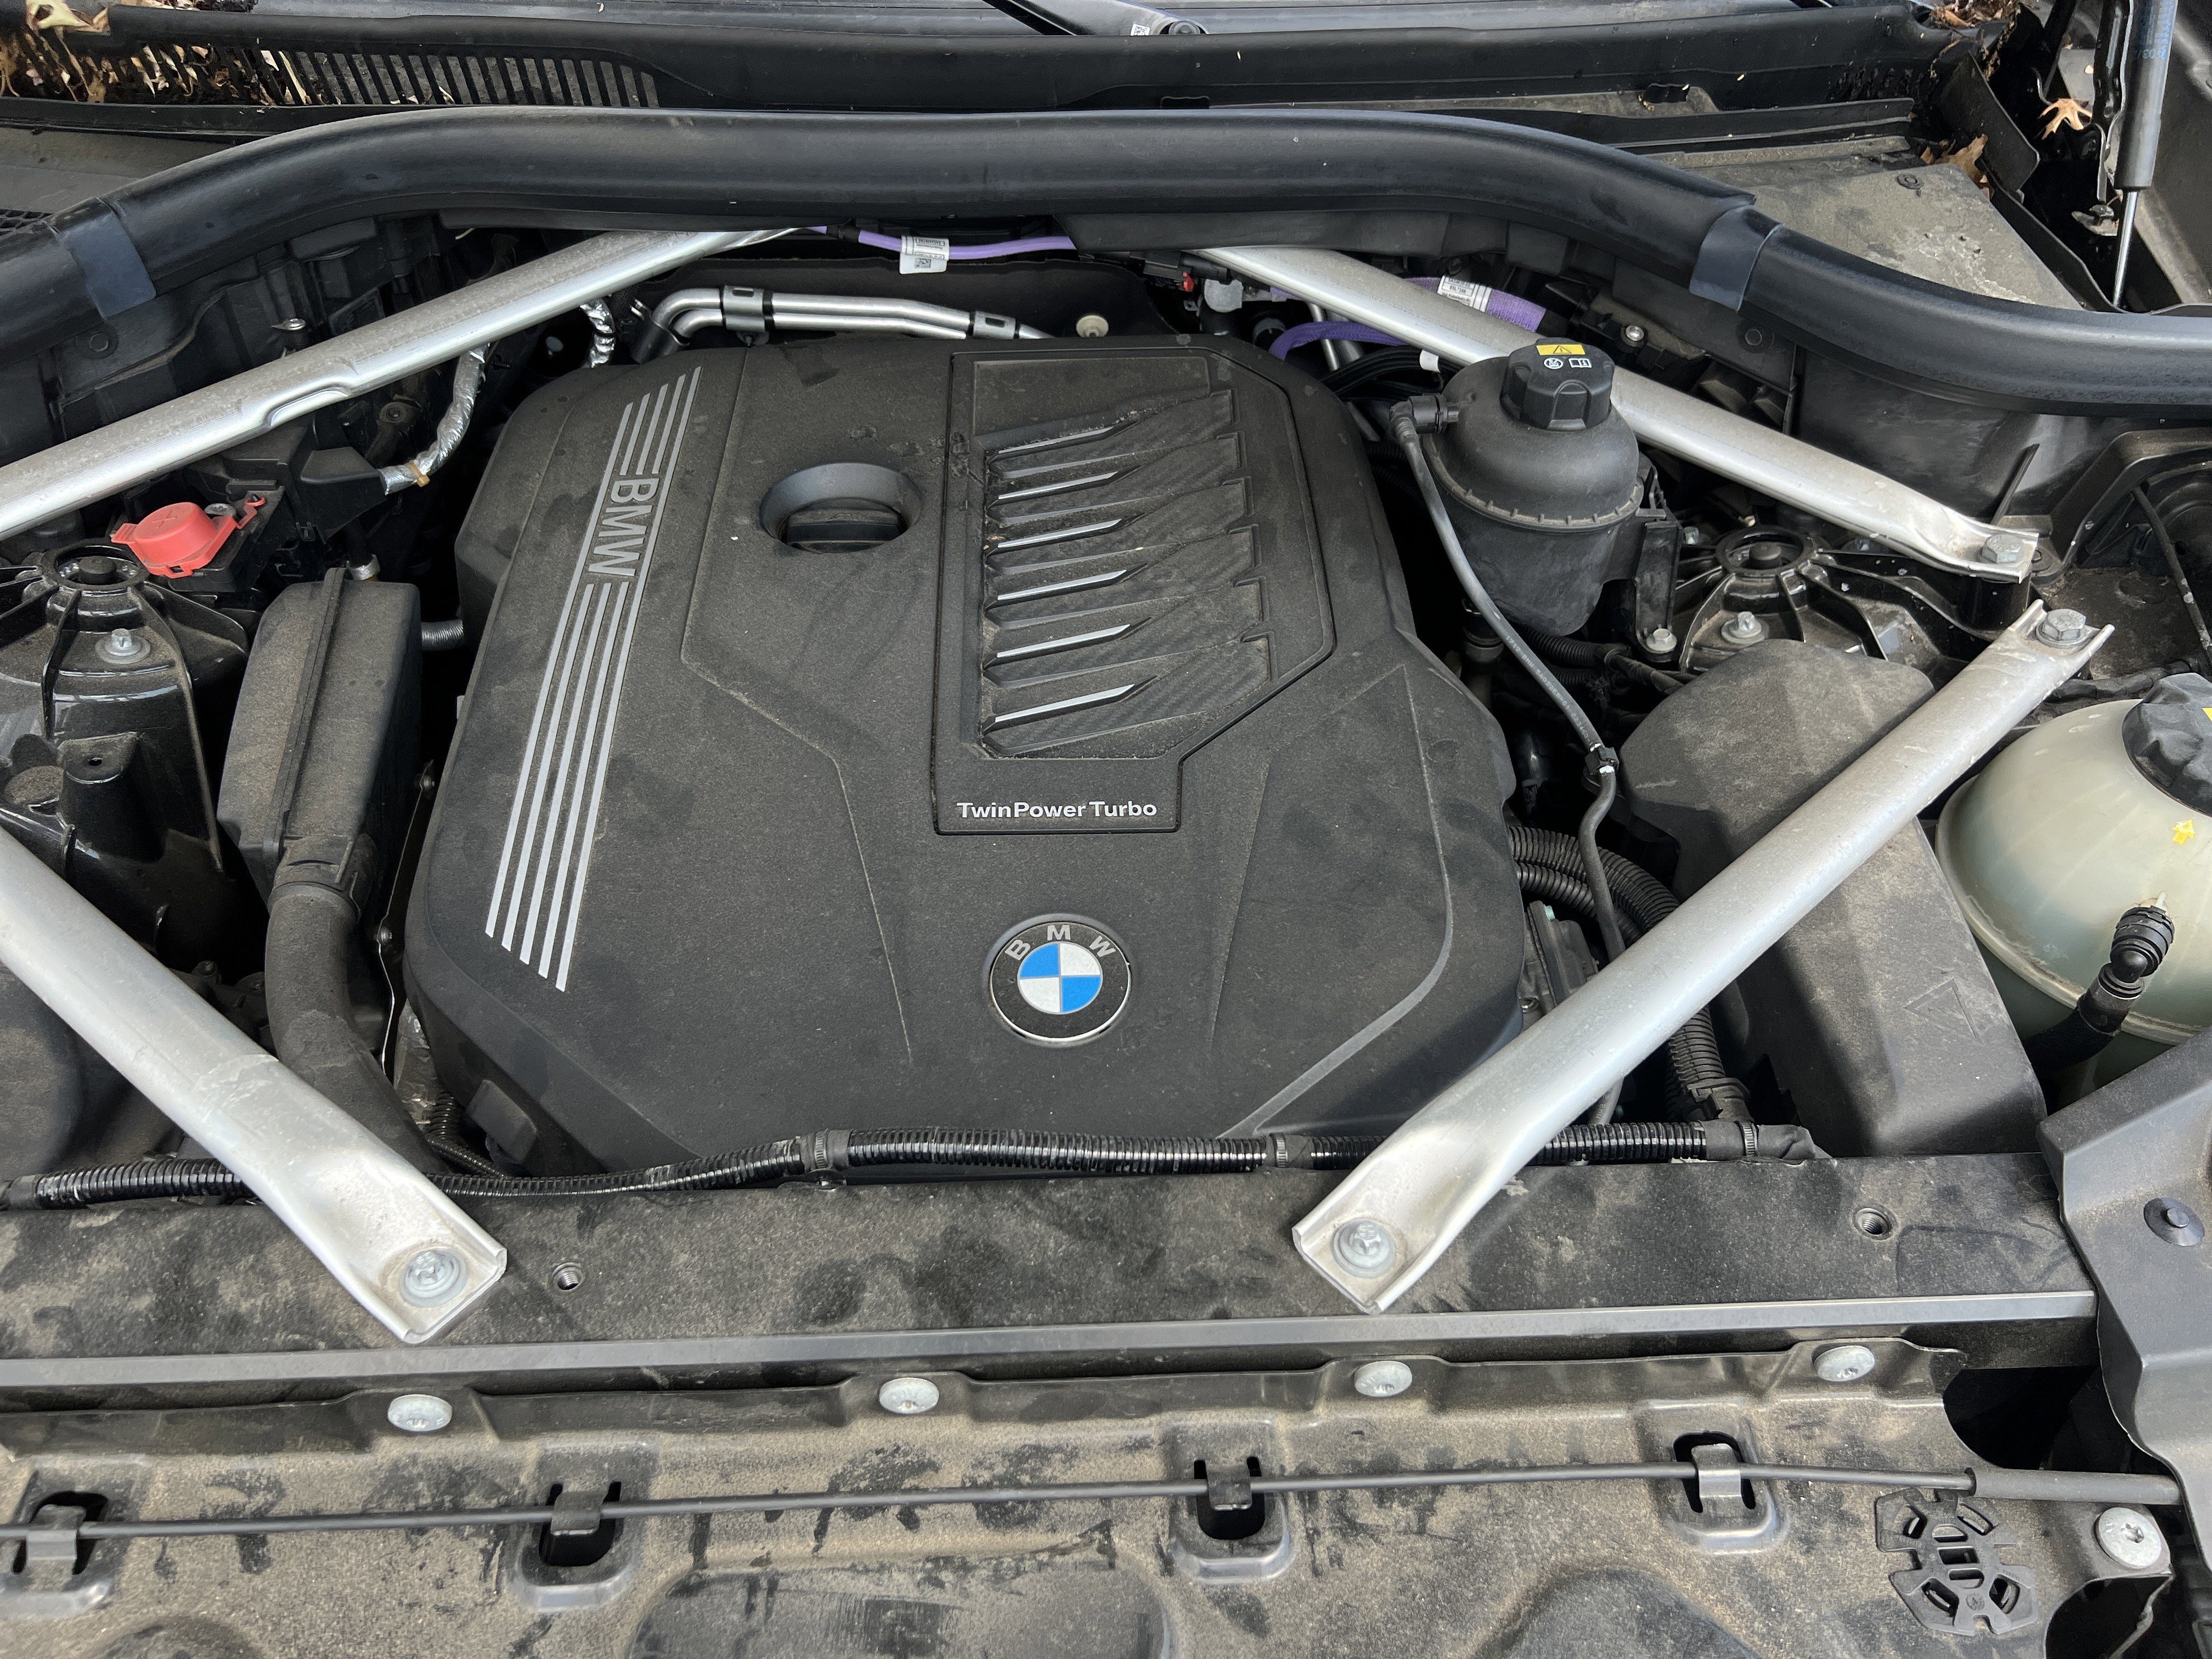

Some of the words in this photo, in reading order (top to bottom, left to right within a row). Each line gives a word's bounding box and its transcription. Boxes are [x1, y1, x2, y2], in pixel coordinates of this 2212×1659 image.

[588, 478, 660, 577] BMW
[1521, 653, 1534, 668] BMW
[1088, 800, 1158, 817] Turbo
[1005, 924, 1116, 961] BMW
